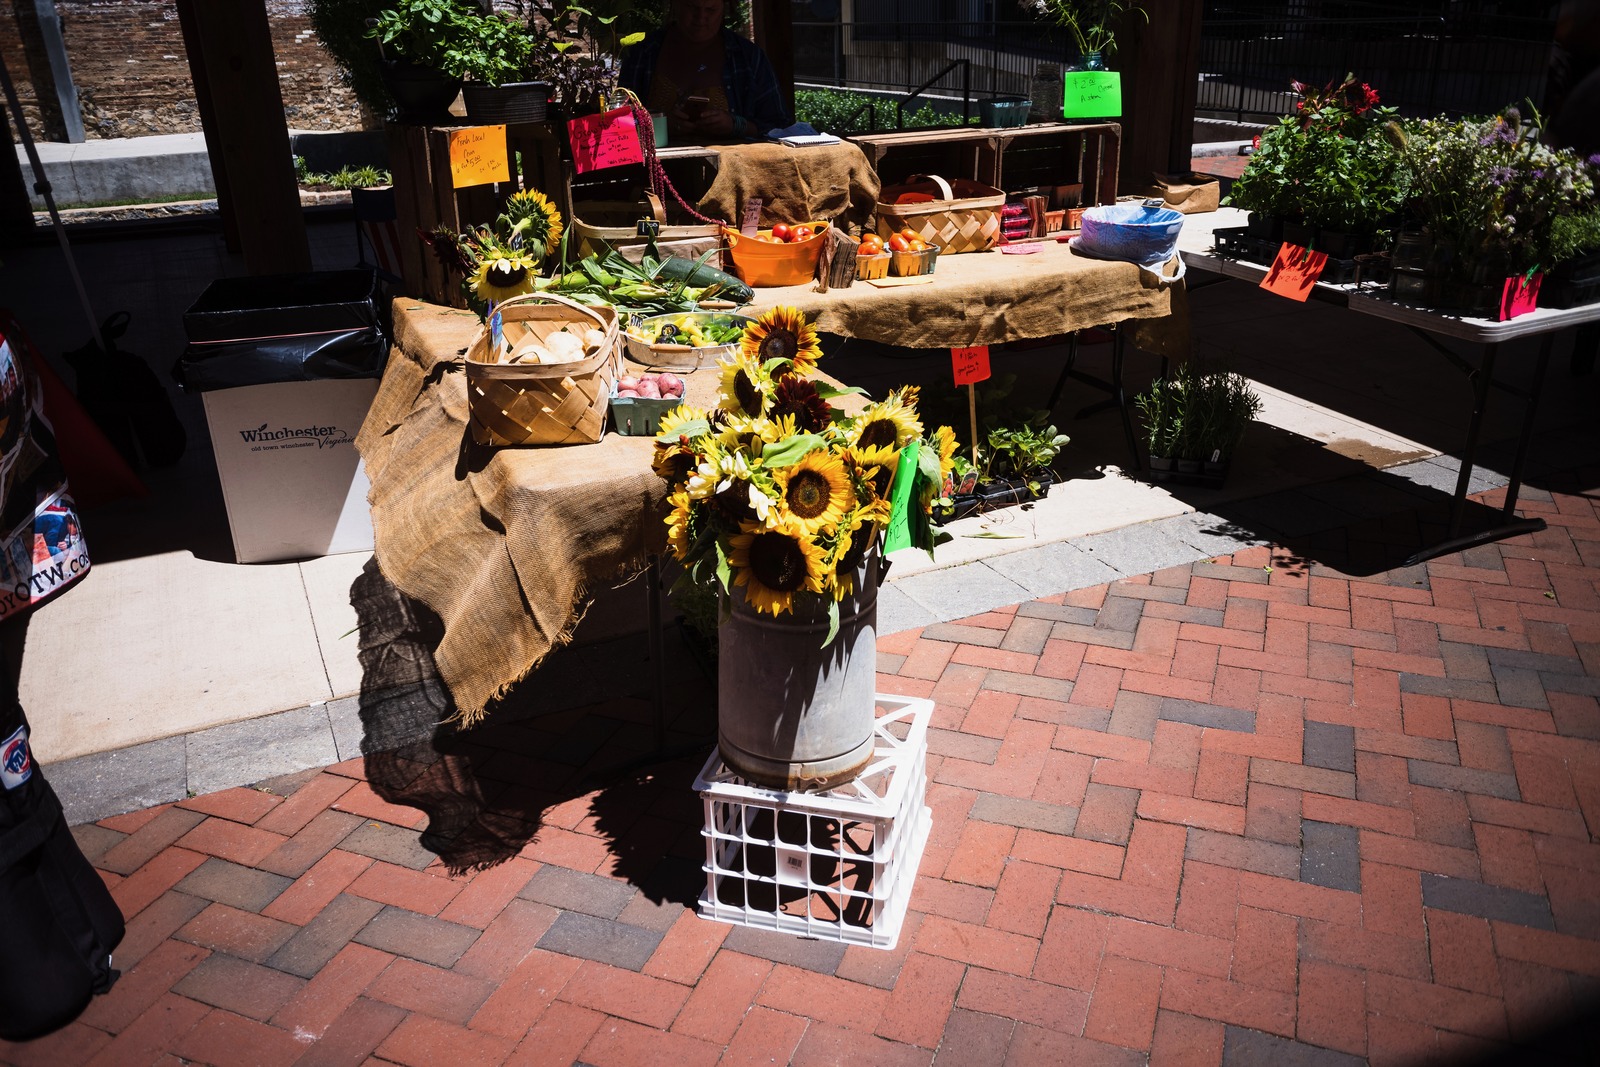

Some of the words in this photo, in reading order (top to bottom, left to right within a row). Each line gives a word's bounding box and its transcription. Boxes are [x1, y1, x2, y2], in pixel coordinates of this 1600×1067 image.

[456, 135, 470, 146] Fresh
[472, 132, 485, 143] Local
[240, 424, 337, 443] Winchester
[280, 441, 315, 450] winchester
